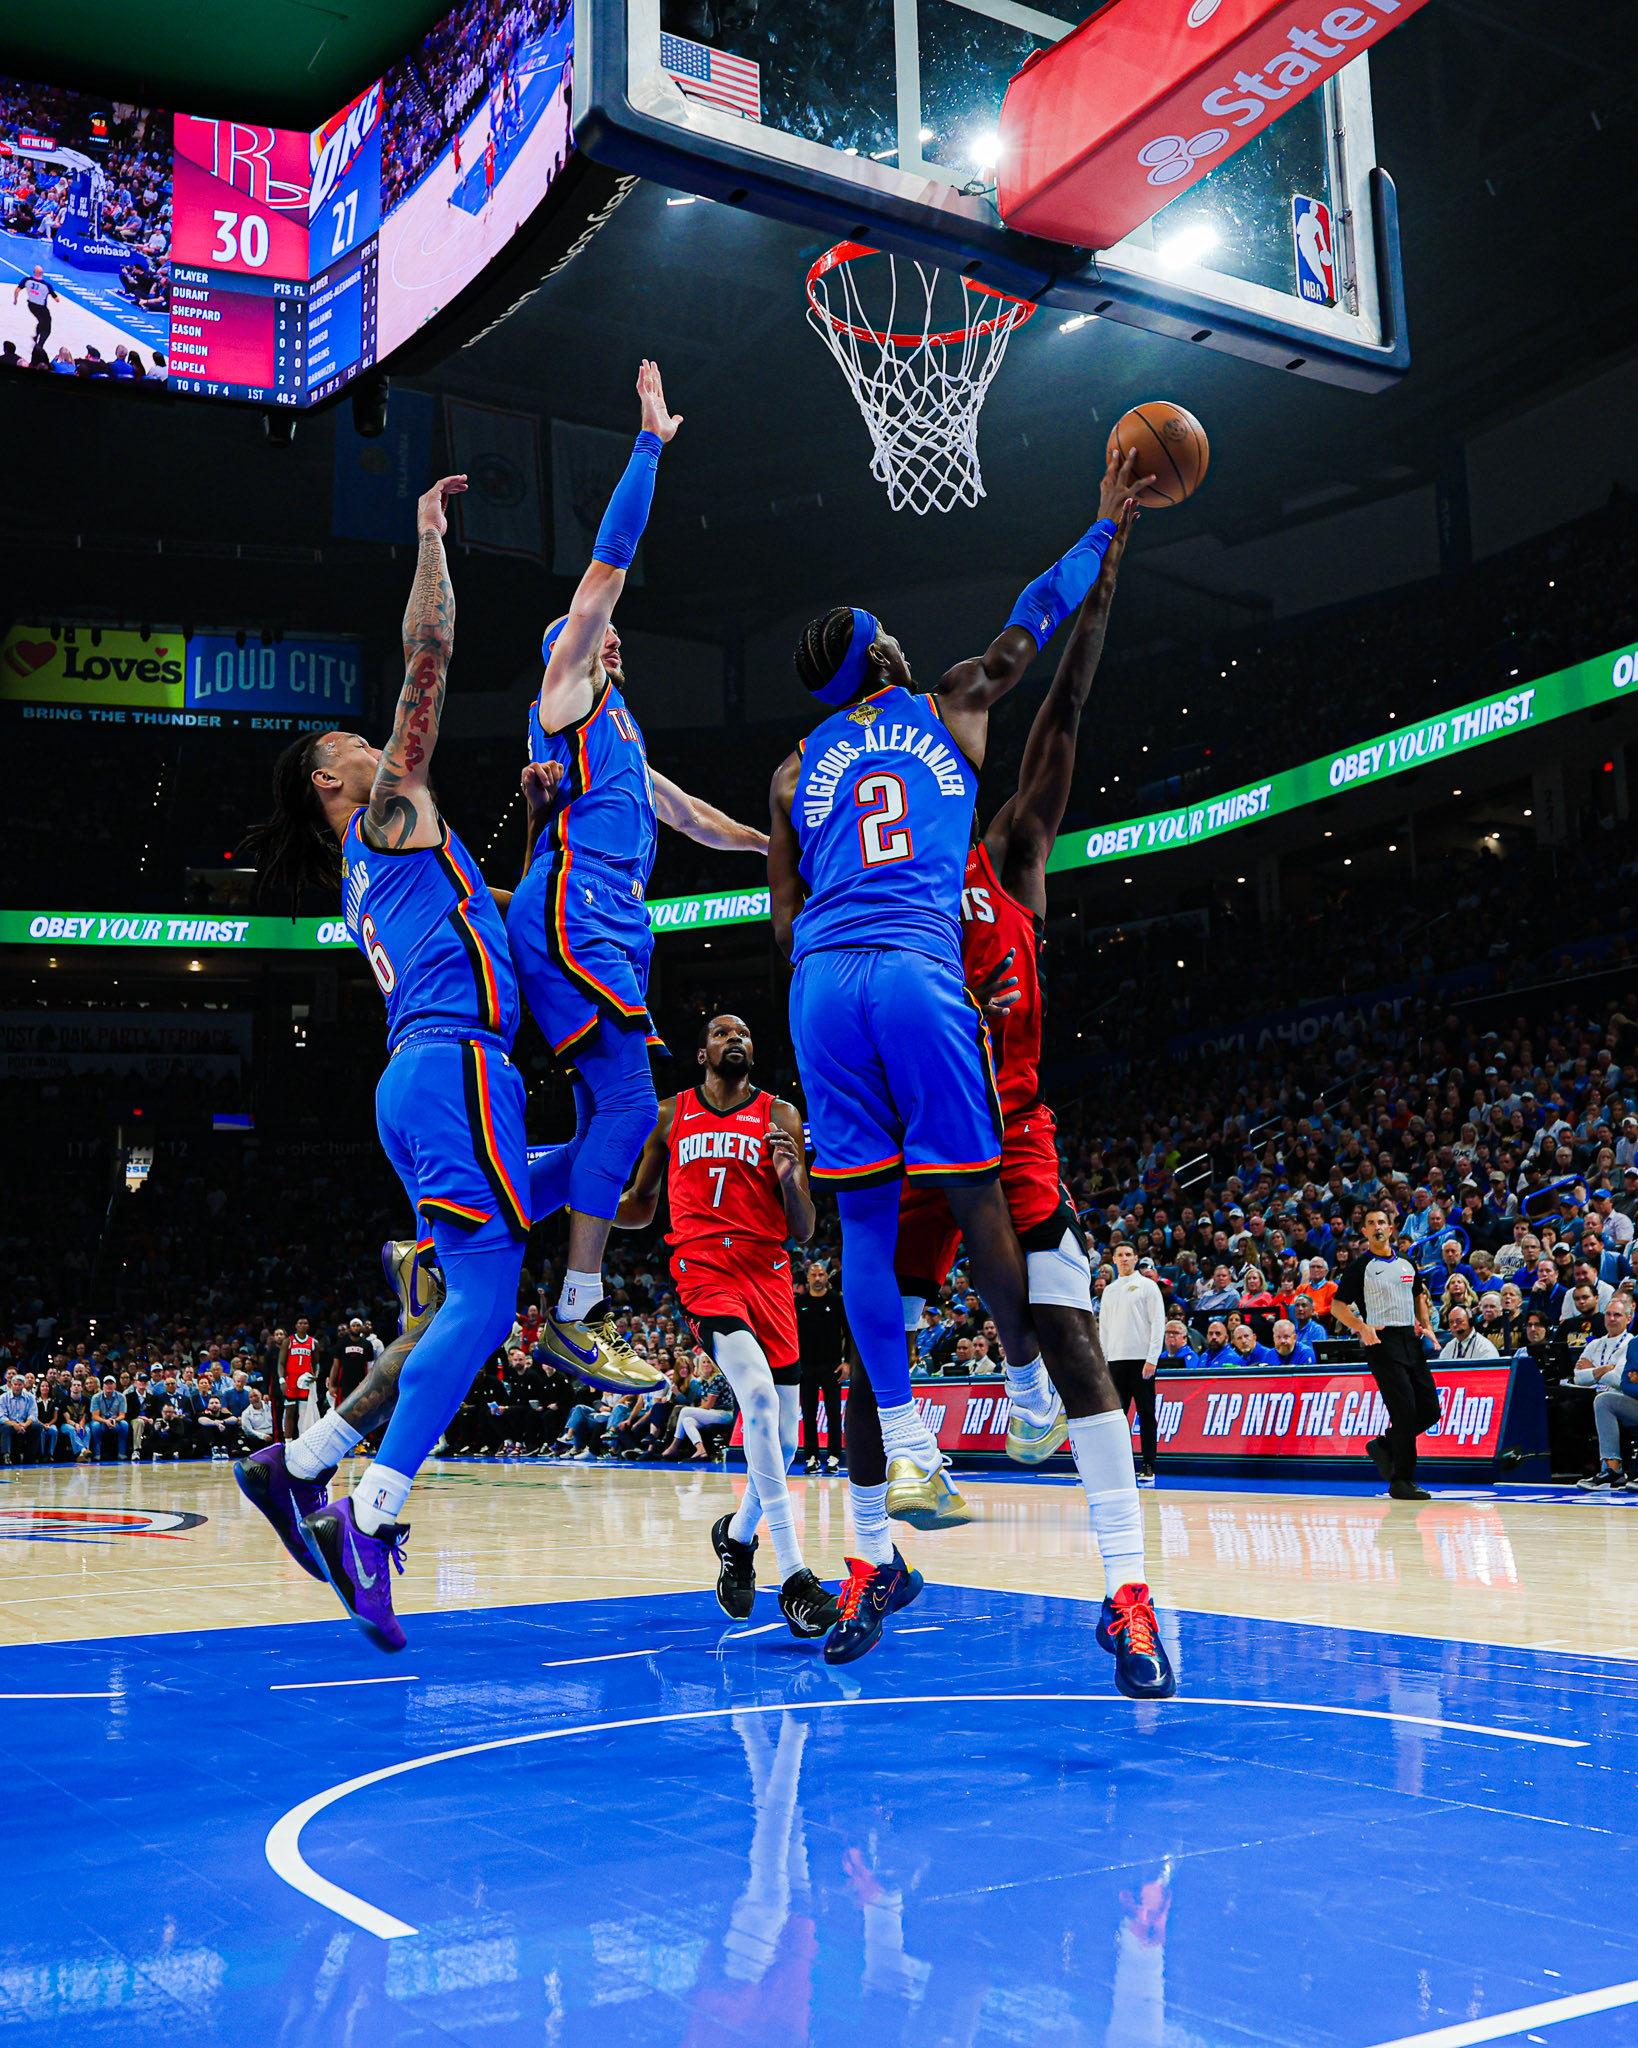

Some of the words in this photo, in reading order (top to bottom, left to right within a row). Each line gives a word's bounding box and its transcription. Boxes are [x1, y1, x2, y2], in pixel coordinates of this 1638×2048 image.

[308, 81, 381, 221] OKC
[211, 210, 269, 267] 30
[331, 189, 359, 257] 27
[84, 245, 131, 258] coinbase
[174, 269, 208, 283] PLAYER
[274, 283, 291, 295] PTS
[294, 286, 305, 296] FL
[310, 275, 328, 295] PLAYER
[361, 244, 371, 260] PTS
[173, 287, 209, 301] DURANT
[280, 302, 286, 312] 8
[297, 304, 301, 314] 1
[1303, 279, 1323, 300] NBA
[172, 305, 220, 321] SHEPPARD
[280, 320, 286, 330] 3
[297, 322, 301, 332] 1
[172, 323, 202, 337] EASON
[280, 338, 286, 348] 0
[295, 340, 301, 350] 0
[171, 342, 208, 356] SENGUN
[279, 356, 285, 366] 2
[295, 358, 301, 368] 0
[171, 360, 205, 374] CAPELA
[279, 375, 284, 384] 2
[295, 376, 300, 386] 0
[177, 380, 188, 390] TO
[194, 382, 200, 392] 6
[208, 384, 218, 395] TF
[223, 386, 229, 396] 4
[248, 389, 264, 400] 1ST
[277, 393, 296, 405] 48.2
[194, 649, 275, 699] LOUD
[289, 649, 356, 704] CITY
[23, 707, 83, 721] BRING
[89, 709, 126, 723] THE
[132, 711, 222, 728] THUNDER
[251, 717, 292, 730] EXIT
[298, 719, 341, 732] NOW
[1328, 742, 1386, 787] OBEY
[1387, 721, 1448, 767] YOUR
[803, 723, 966, 828] GILGEOUS-ALEXANDER
[854, 771, 914, 869] 2
[1086, 823, 1145, 858] OBEY
[1146, 808, 1205, 846] YOUR
[647, 901, 700, 927] YOUR
[703, 892, 771, 921] THIRST
[29, 916, 96, 939] OBEY
[96, 917, 163, 941] YOUR
[317, 922, 352, 944] OB
[361, 913, 397, 997] 6
[60, 1027, 89, 1042] OAK
[97, 1028, 149, 1043] PARTY
[160, 1028, 232, 1044] TERRACE
[678, 1132, 762, 1167] ROCKETS
[708, 1166, 727, 1208] 7
[299, 1355, 303, 1365] 1
[962, 1397, 995, 1435] TAP
[1202, 1393, 1242, 1436] TAP
[1241, 1392, 1295, 1437] INTO
[1296, 1391, 1342, 1436] THE
[1340, 1391, 1391, 1437] GAM
[1445, 1387, 1494, 1444] App
